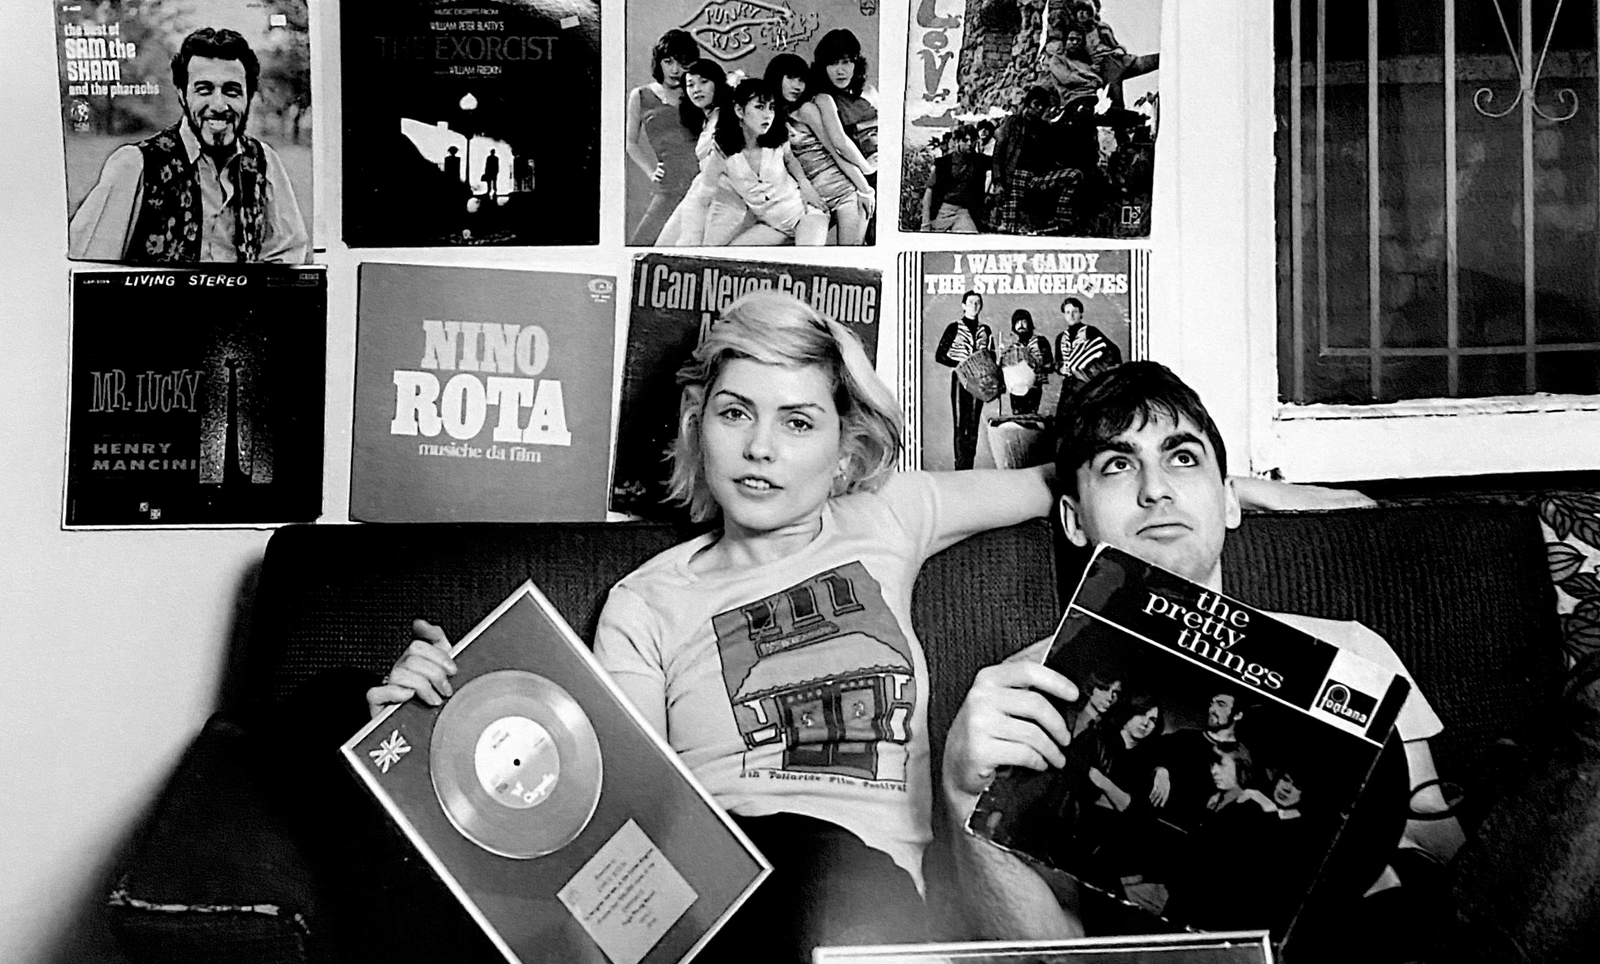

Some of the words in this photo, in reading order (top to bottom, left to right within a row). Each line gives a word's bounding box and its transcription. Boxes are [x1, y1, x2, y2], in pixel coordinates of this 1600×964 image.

[64, 22, 82, 36] the
[710, 26, 753, 51] KISS
[65, 38, 107, 59] SAM
[108, 38, 136, 59] the
[434, 35, 560, 61] EXORCIST
[67, 60, 121, 81] SHAM
[68, 81, 89, 96] and
[91, 81, 109, 96] the
[110, 81, 160, 99] pharaohs
[954, 253, 963, 273] I
[966, 253, 1027, 273] WANT
[1031, 253, 1100, 273] CANDY
[124, 274, 176, 287] LIVING
[187, 274, 249, 287] STEREO
[924, 273, 966, 294] THE
[637, 263, 649, 308] I
[651, 264, 697, 311] Can
[811, 275, 877, 324] Home
[420, 319, 550, 376] NINO
[88, 368, 132, 413] MR.
[134, 368, 205, 413] LUCKY
[390, 369, 573, 447] ROTA
[93, 442, 173, 455] HENRY
[91, 459, 197, 471] MANCINI
[1196, 589, 1250, 629] the
[1142, 592, 1246, 650] pretty
[1177, 628, 1285, 690] things
